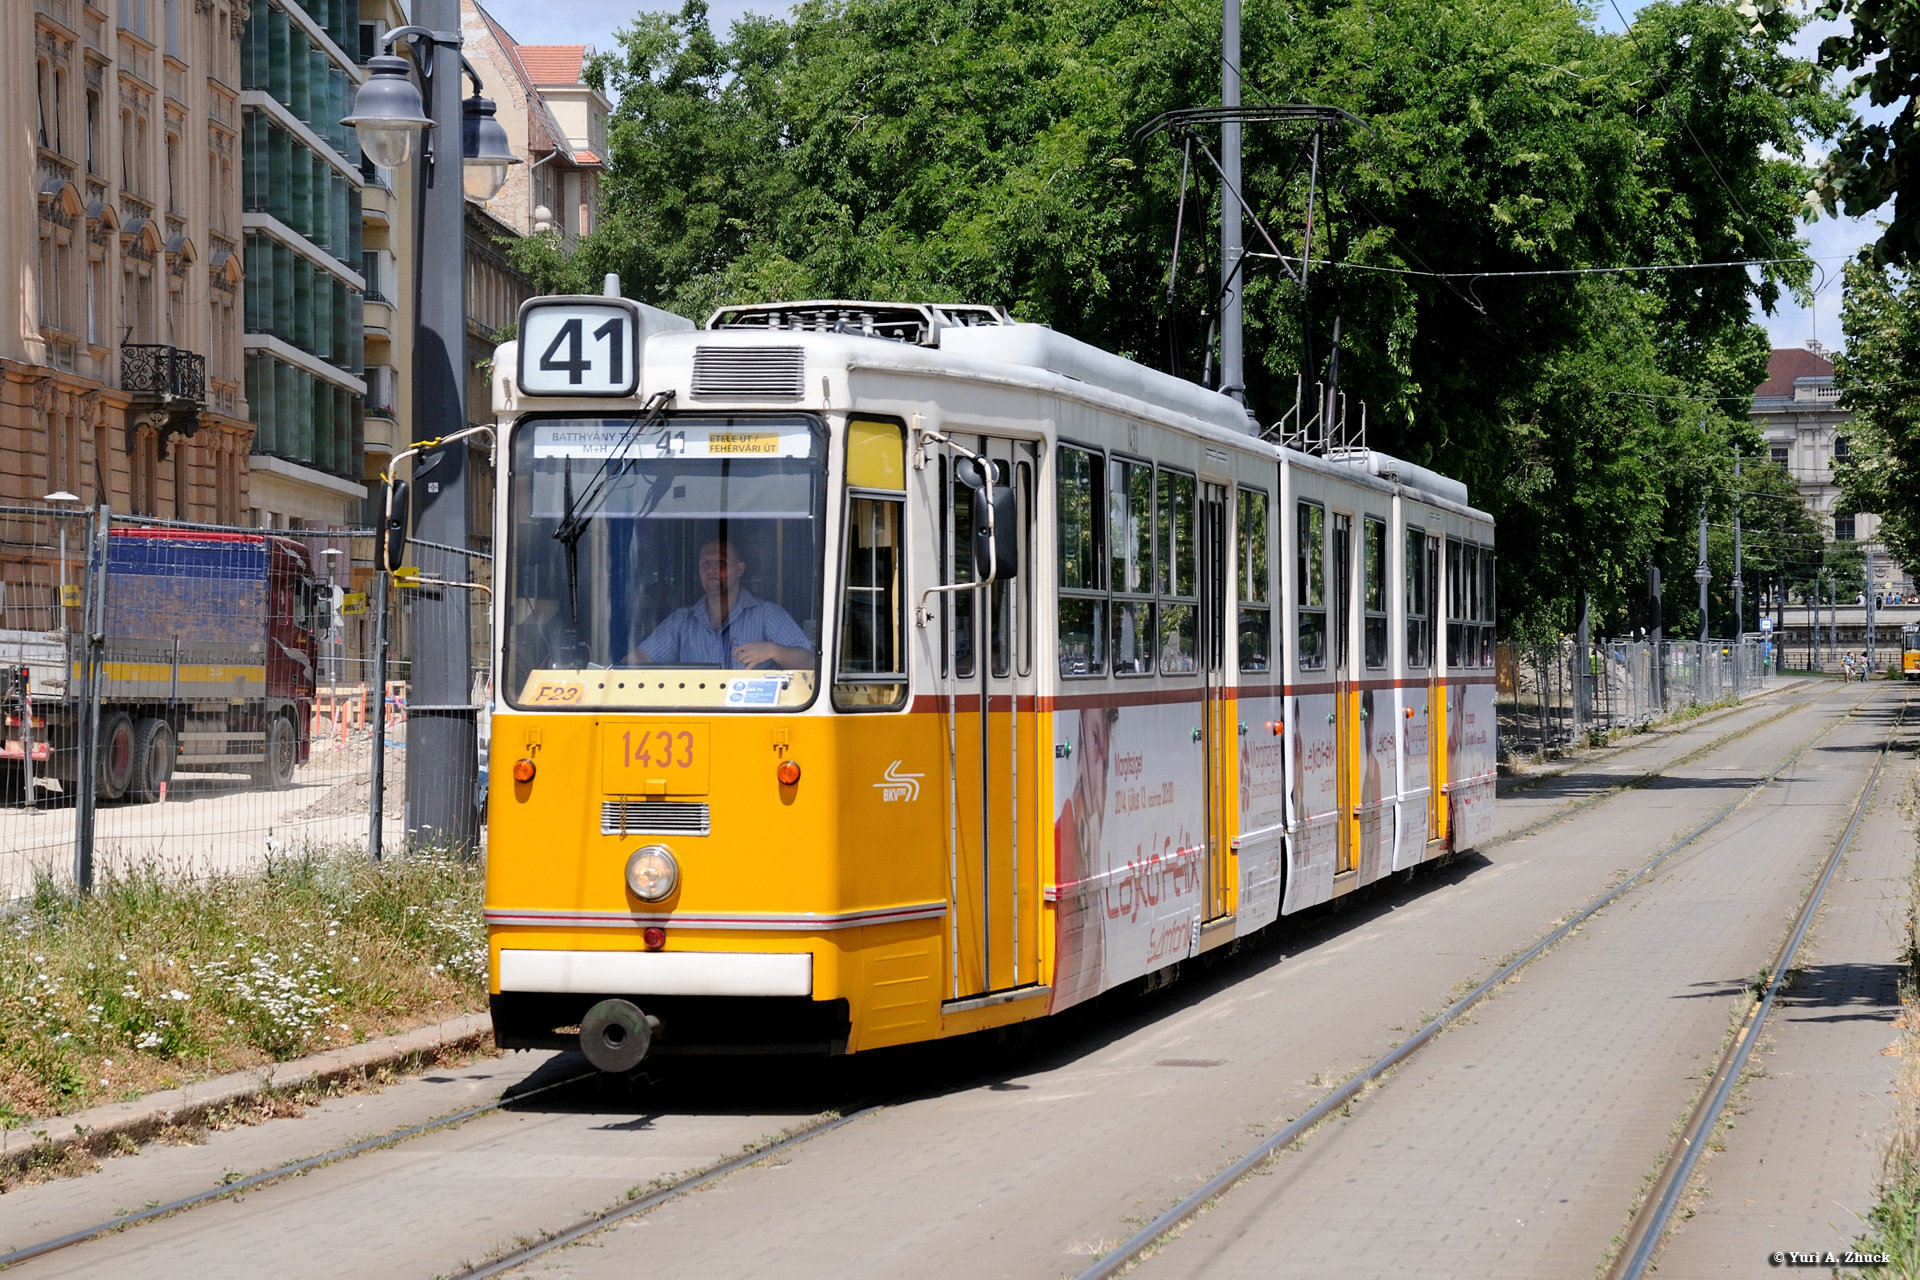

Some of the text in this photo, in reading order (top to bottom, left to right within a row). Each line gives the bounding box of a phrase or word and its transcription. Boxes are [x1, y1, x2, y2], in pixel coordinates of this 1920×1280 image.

[539, 318, 624, 385] 41
[552, 430, 616, 442] BATTHYÁNY
[655, 430, 686, 454] 41
[709, 434, 737, 443] ETELE
[739, 433, 752, 443] ÚT
[583, 445, 607, 453] M+H
[763, 442, 776, 453] ÚT
[535, 686, 578, 702] F23
[622, 730, 694, 769] 1433
[883, 788, 899, 802] BKV
